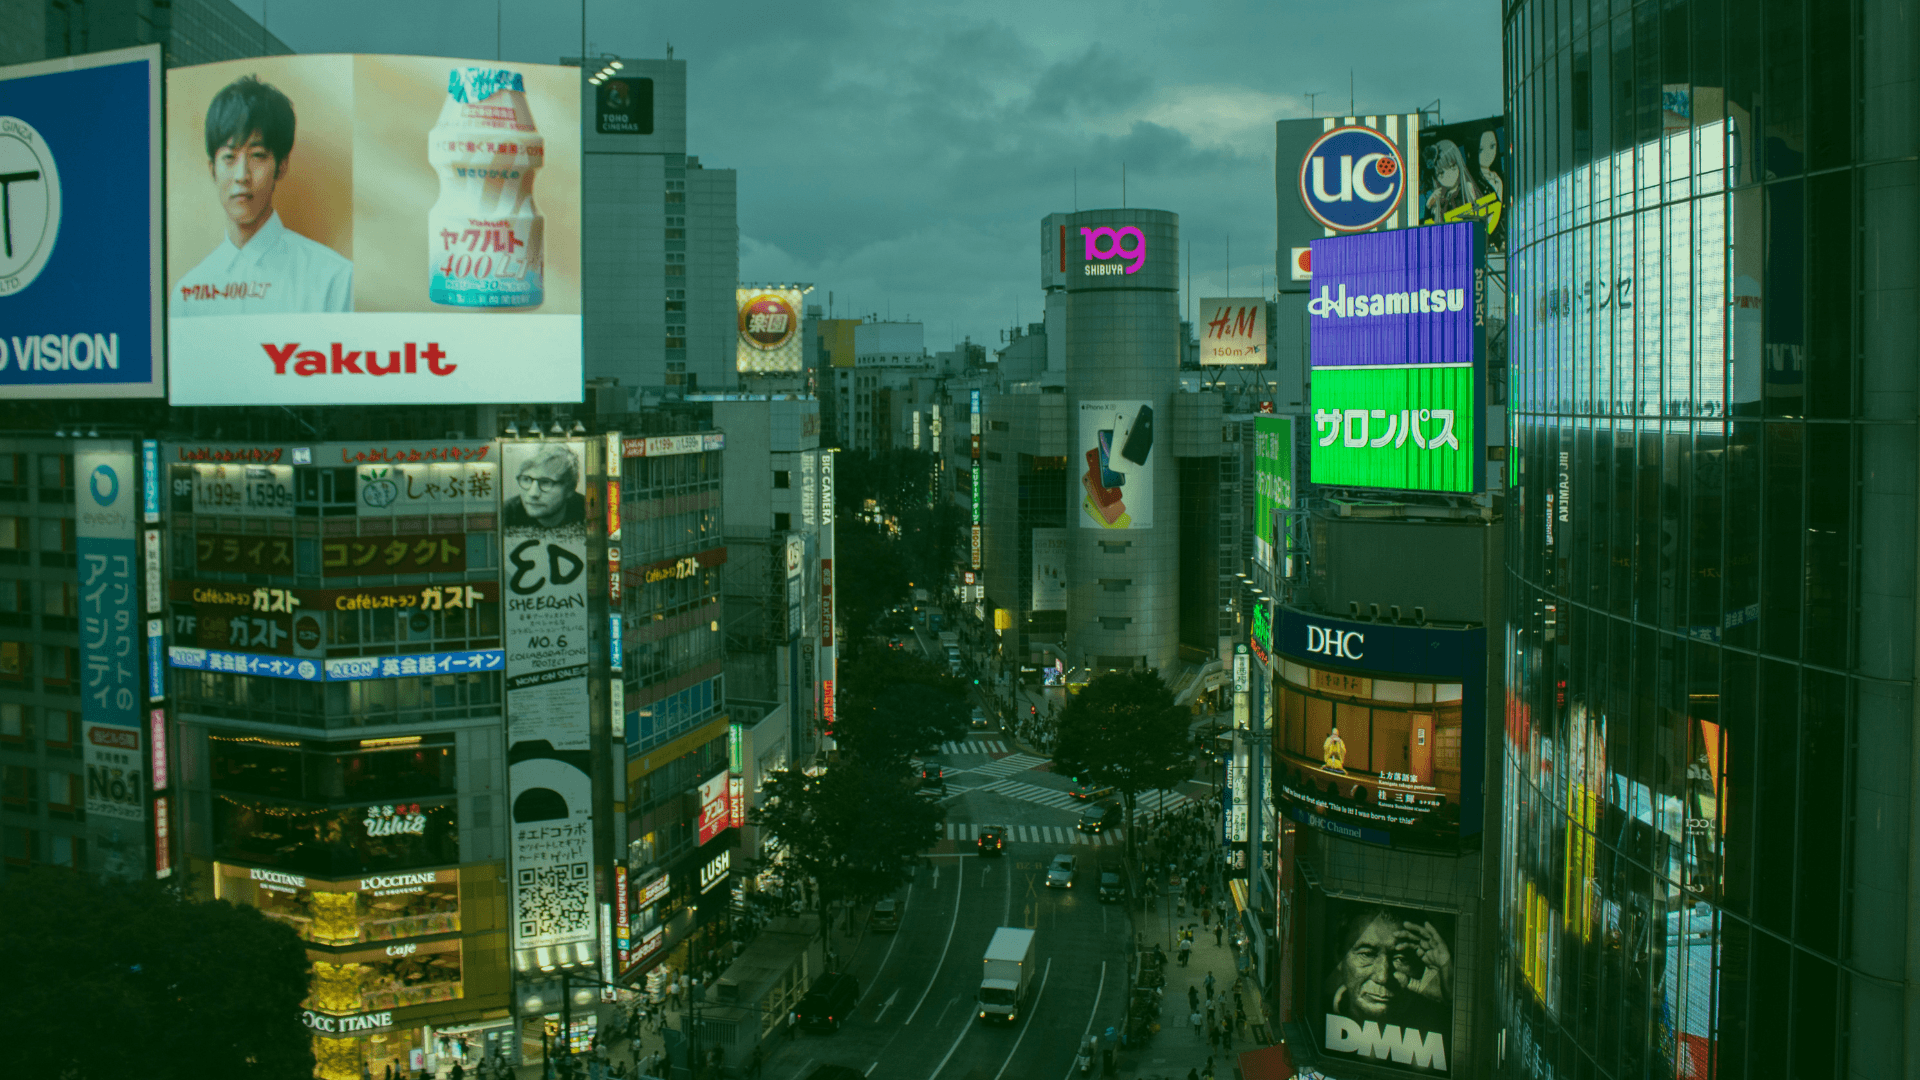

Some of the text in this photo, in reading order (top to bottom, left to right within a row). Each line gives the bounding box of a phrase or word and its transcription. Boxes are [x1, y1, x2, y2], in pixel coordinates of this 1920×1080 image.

[1, 119, 34, 143] GINZA
[602, 113, 629, 123] TOHO
[602, 123, 638, 131] CINEMAS
[440, 227, 524, 254] ヤクルト
[1080, 225, 1146, 275] 109
[1084, 264, 1123, 276] SHIBUYA
[1307, 284, 1465, 318] Hisamitsu
[1474, 267, 1485, 327] サロンパス
[748, 313, 788, 333] 楽園
[1208, 305, 1259, 340] H&M
[12, 332, 119, 371] VISION
[260, 341, 458, 377] Yakult
[1313, 408, 1459, 451] サロンパス
[341, 445, 490, 464] しゃぶしゃぶバイキング
[173, 479, 192, 497] 9F
[406, 470, 492, 501] しゃぶ葉
[821, 454, 831, 526] BIC CAMERA
[323, 538, 461, 567] コンタクト
[509, 539, 584, 596] ED
[675, 556, 700, 580] ガスト
[252, 586, 301, 615] ガスト
[335, 585, 485, 611] Caféレストラン ガスト
[508, 593, 585, 612] SHEERAN
[84, 553, 111, 710] アイシティ
[112, 554, 134, 711] コンタクトの
[175, 615, 198, 635] 7F
[229, 615, 288, 649] ガスト
[1306, 624, 1364, 660] DHC
[209, 653, 295, 675] 英会話イーオン
[331, 653, 501, 676] AEON 英会話イーオン
[515, 674, 540, 687] NOW
[541, 671, 557, 682] ON
[86, 763, 142, 806] No.1
[1307, 812, 1362, 839] DHC Channel
[1358, 810, 1370, 818] was
[1370, 811, 1386, 821] born
[1386, 814, 1398, 823] for
[518, 822, 587, 842] #エドコラボ
[361, 872, 436, 890] L'OCCITANE
[700, 850, 731, 888] LUSH
[386, 886, 424, 896] PROVENCE
[1324, 1013, 1448, 1072] DMM
